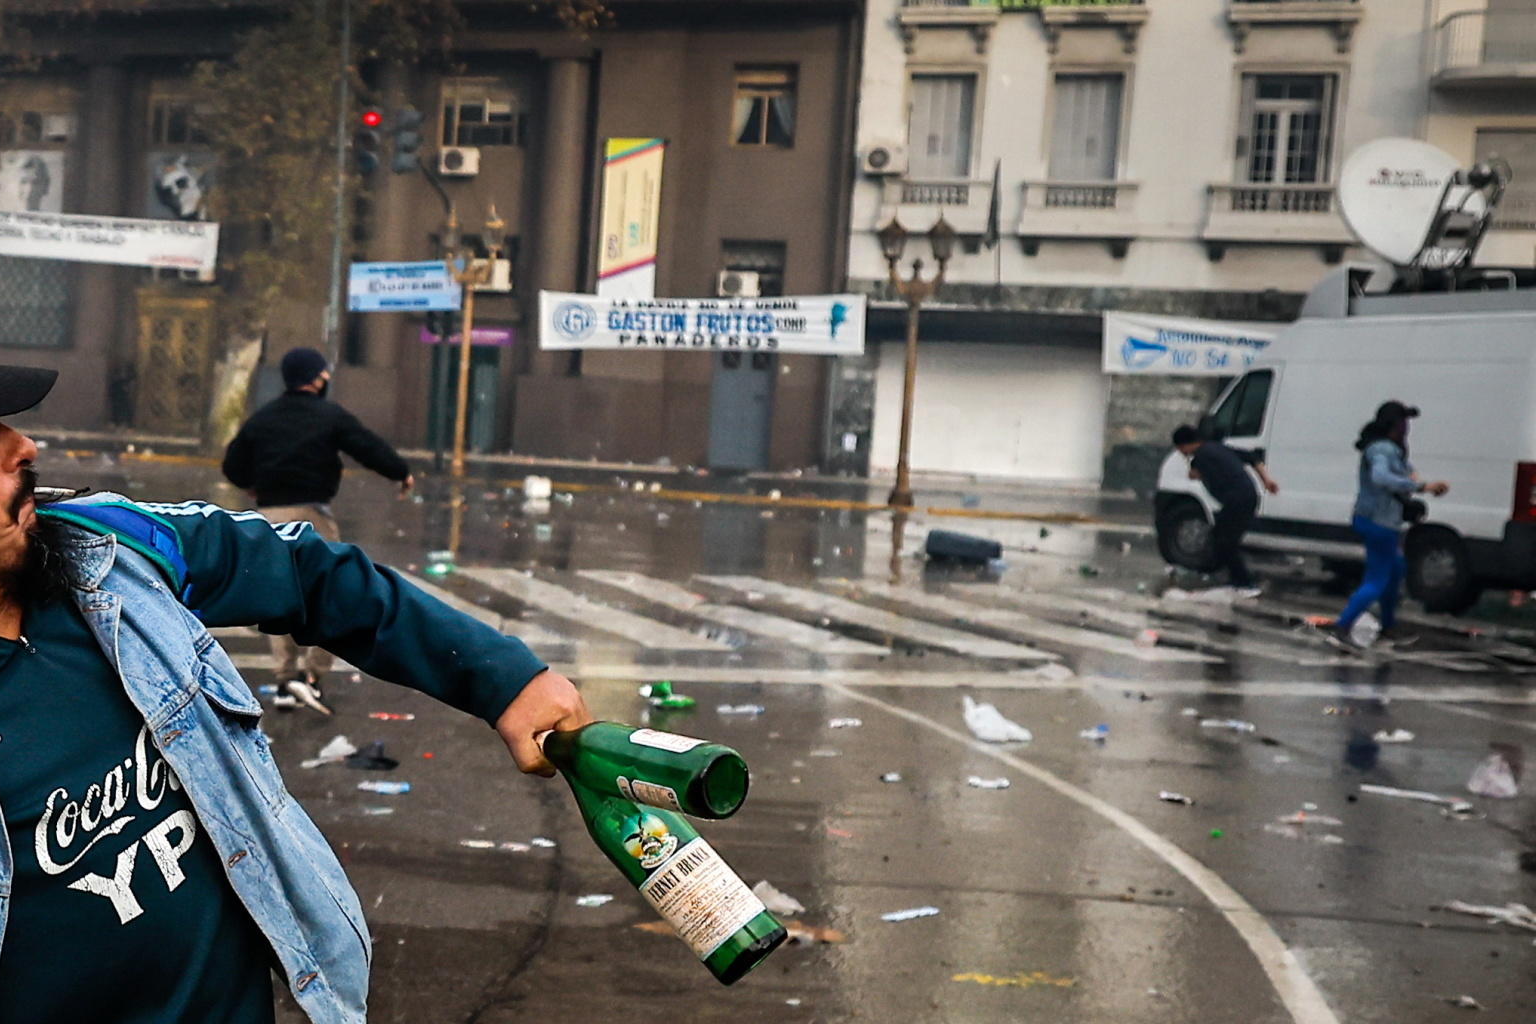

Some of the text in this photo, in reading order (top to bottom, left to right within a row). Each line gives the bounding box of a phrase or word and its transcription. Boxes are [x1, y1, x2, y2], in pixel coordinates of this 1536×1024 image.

[607, 310, 686, 332] GASTON
[696, 311, 775, 334] FRUTOS
[618, 333, 780, 347] PANADEROS
